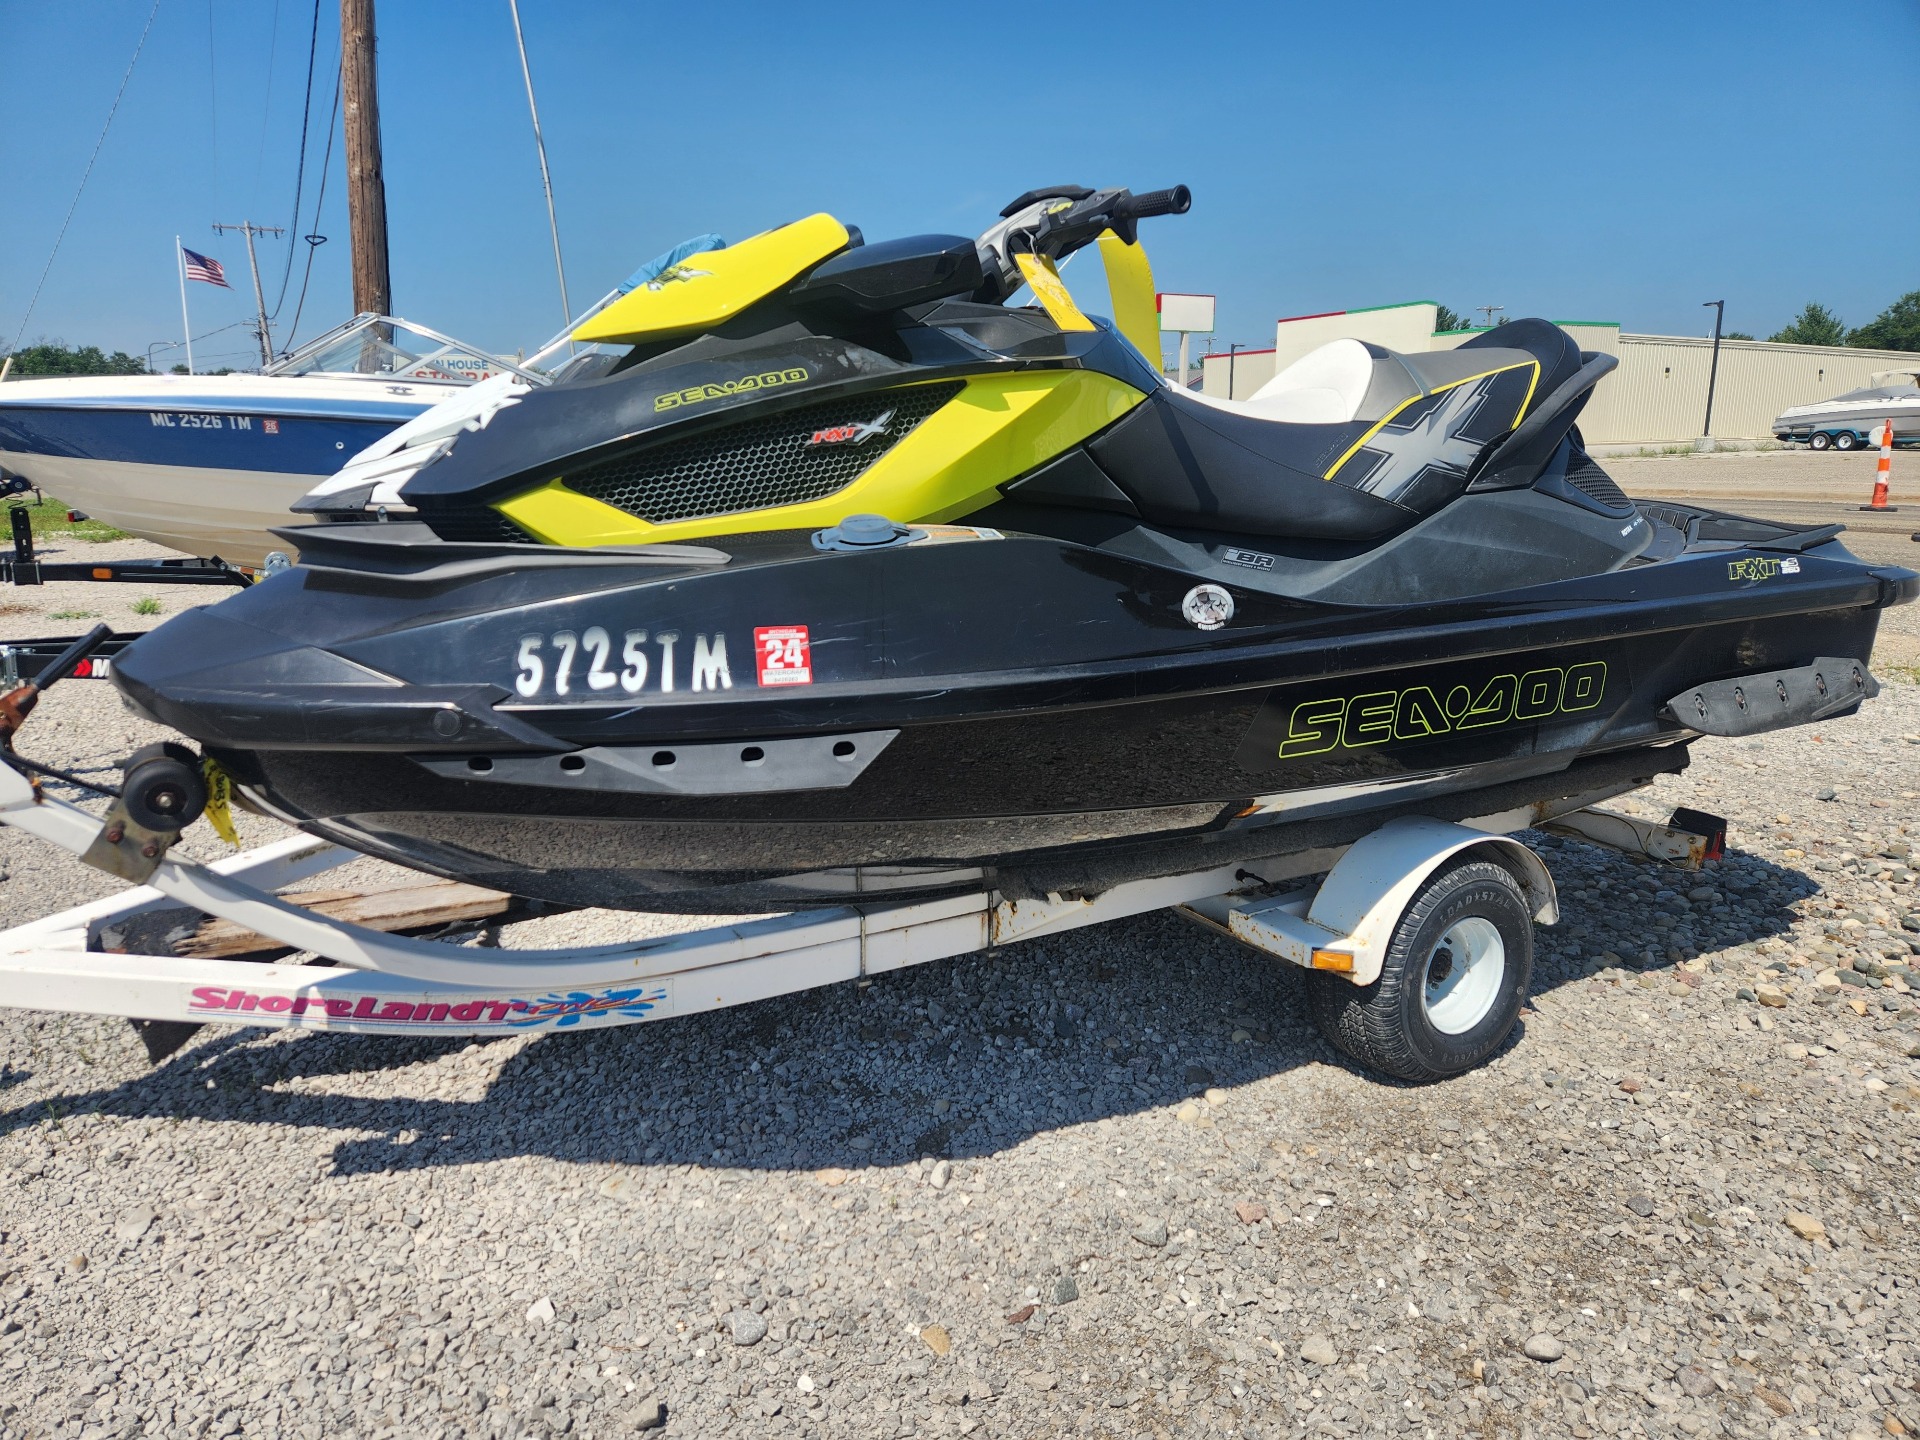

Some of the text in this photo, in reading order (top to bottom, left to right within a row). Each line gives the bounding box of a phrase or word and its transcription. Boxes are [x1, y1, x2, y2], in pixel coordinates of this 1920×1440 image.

[447, 360, 489, 370] HOUSE
[150, 413, 252, 430] MC 2526 TM
[765, 639, 804, 669] 24
